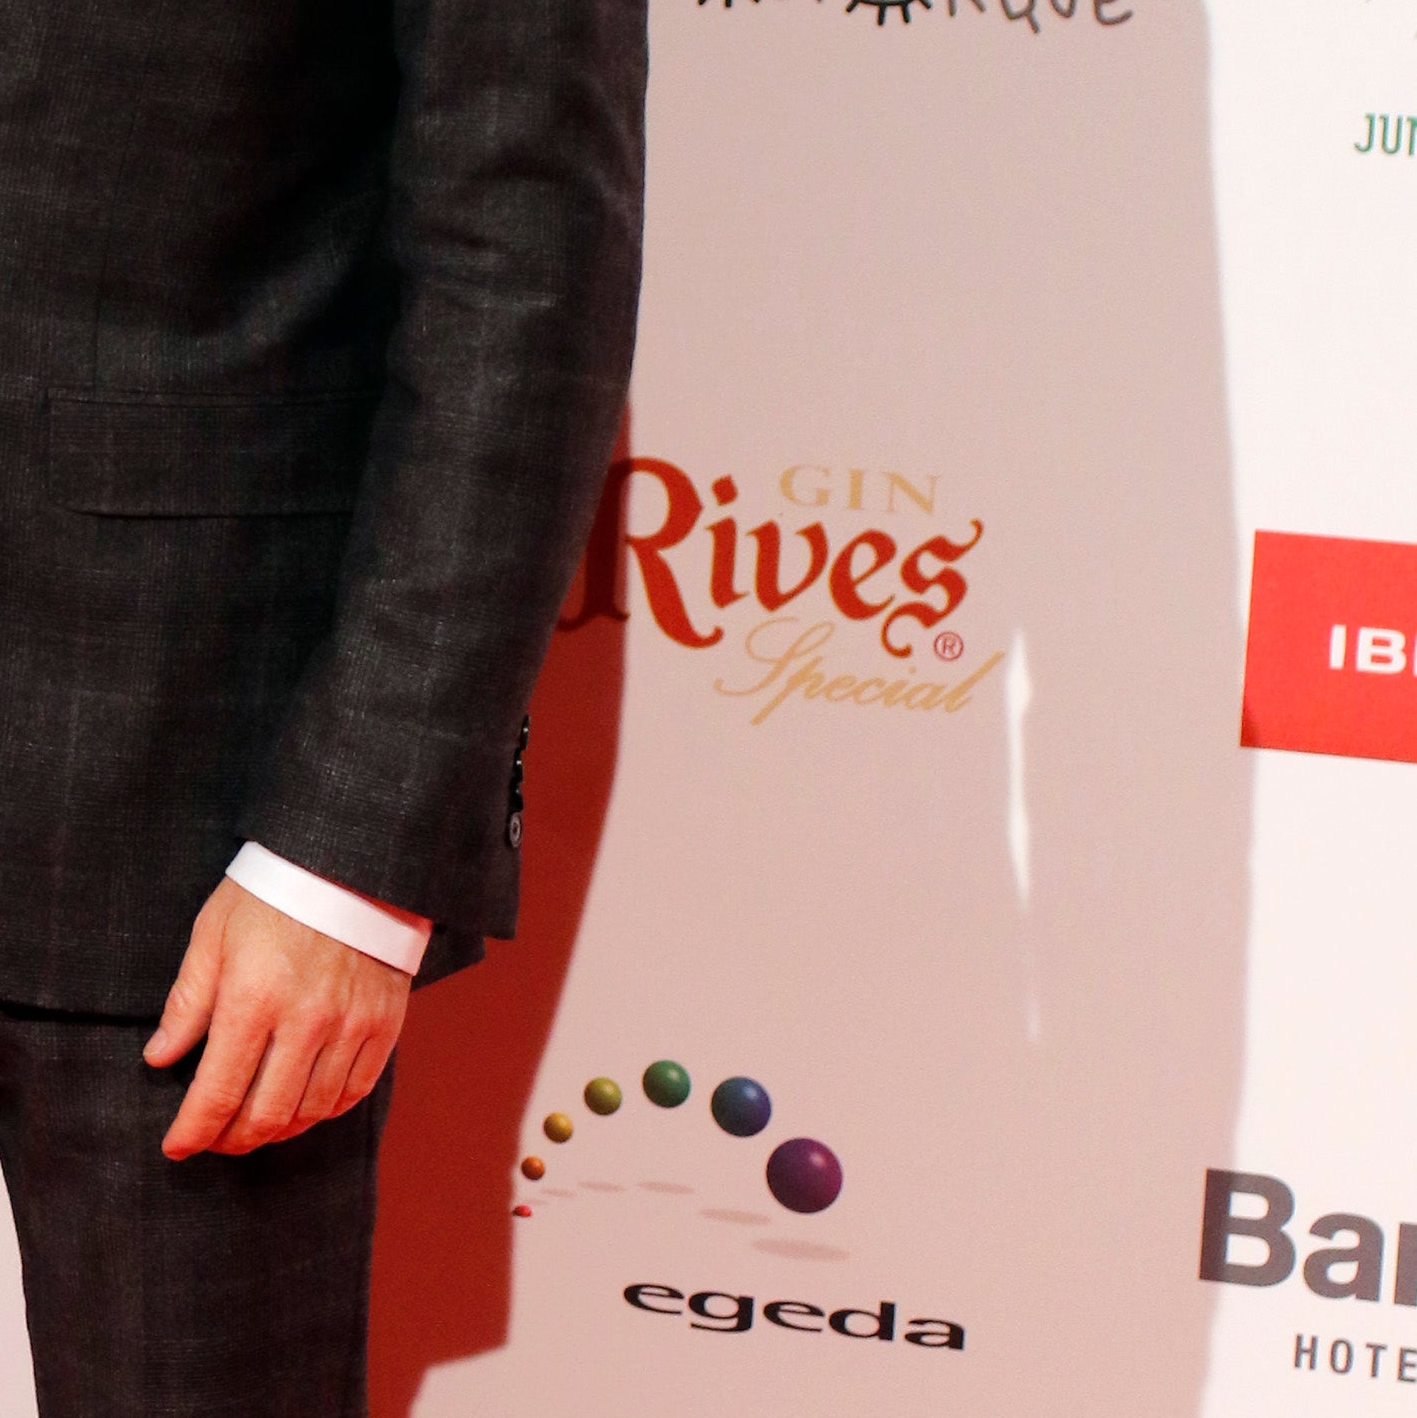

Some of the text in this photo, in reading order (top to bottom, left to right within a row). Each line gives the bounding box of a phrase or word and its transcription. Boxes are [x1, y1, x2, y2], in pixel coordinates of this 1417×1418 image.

[779, 464, 942, 516] GIN
[554, 456, 984, 659] Rives
[714, 616, 1005, 726] Special
[1329, 624, 1417, 677] IB
[622, 1283, 966, 1352] egeda
